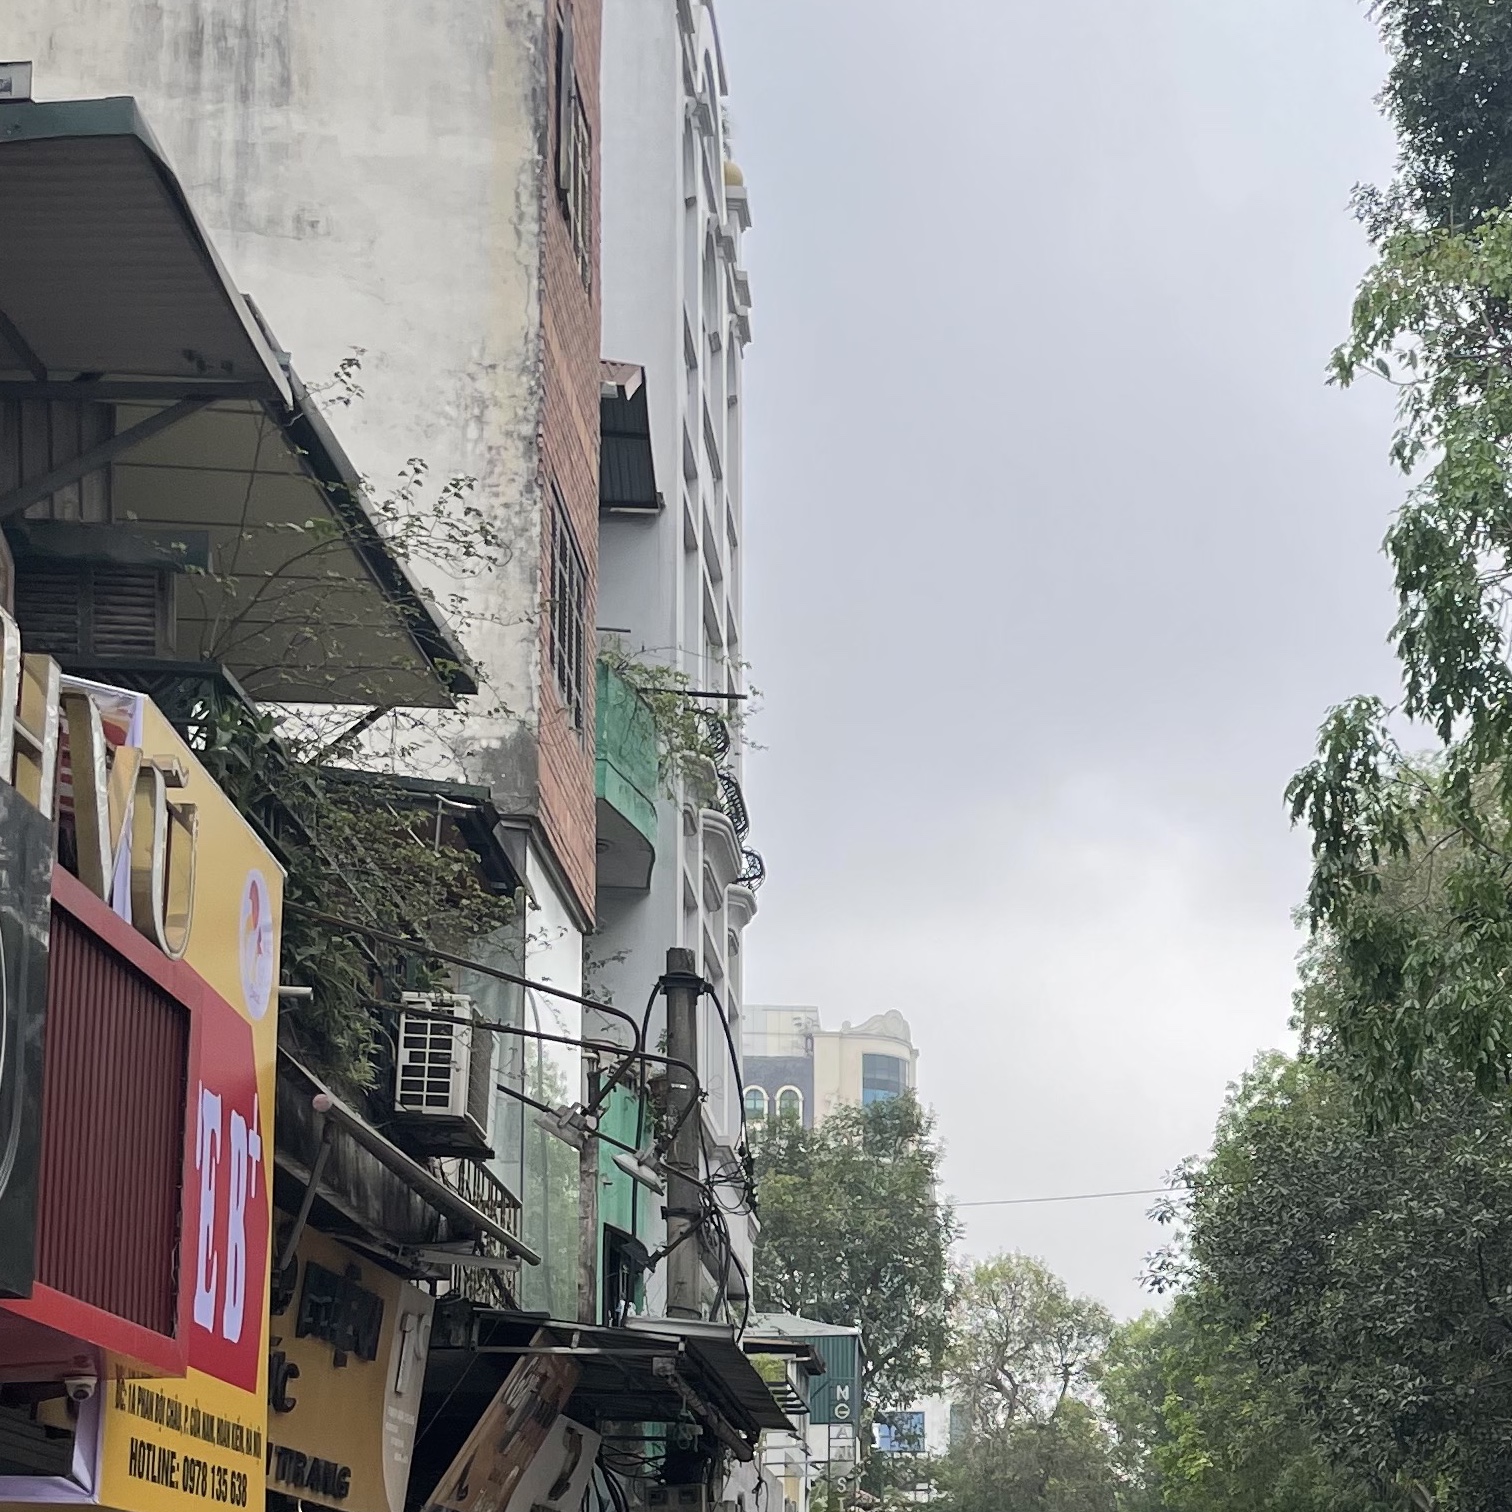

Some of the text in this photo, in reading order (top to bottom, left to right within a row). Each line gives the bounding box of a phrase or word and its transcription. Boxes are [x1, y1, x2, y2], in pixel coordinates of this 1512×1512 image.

[128, 1436, 248, 1508] HOTLINE: 0978 135 638
[275, 1445, 351, 1500] TRANG
